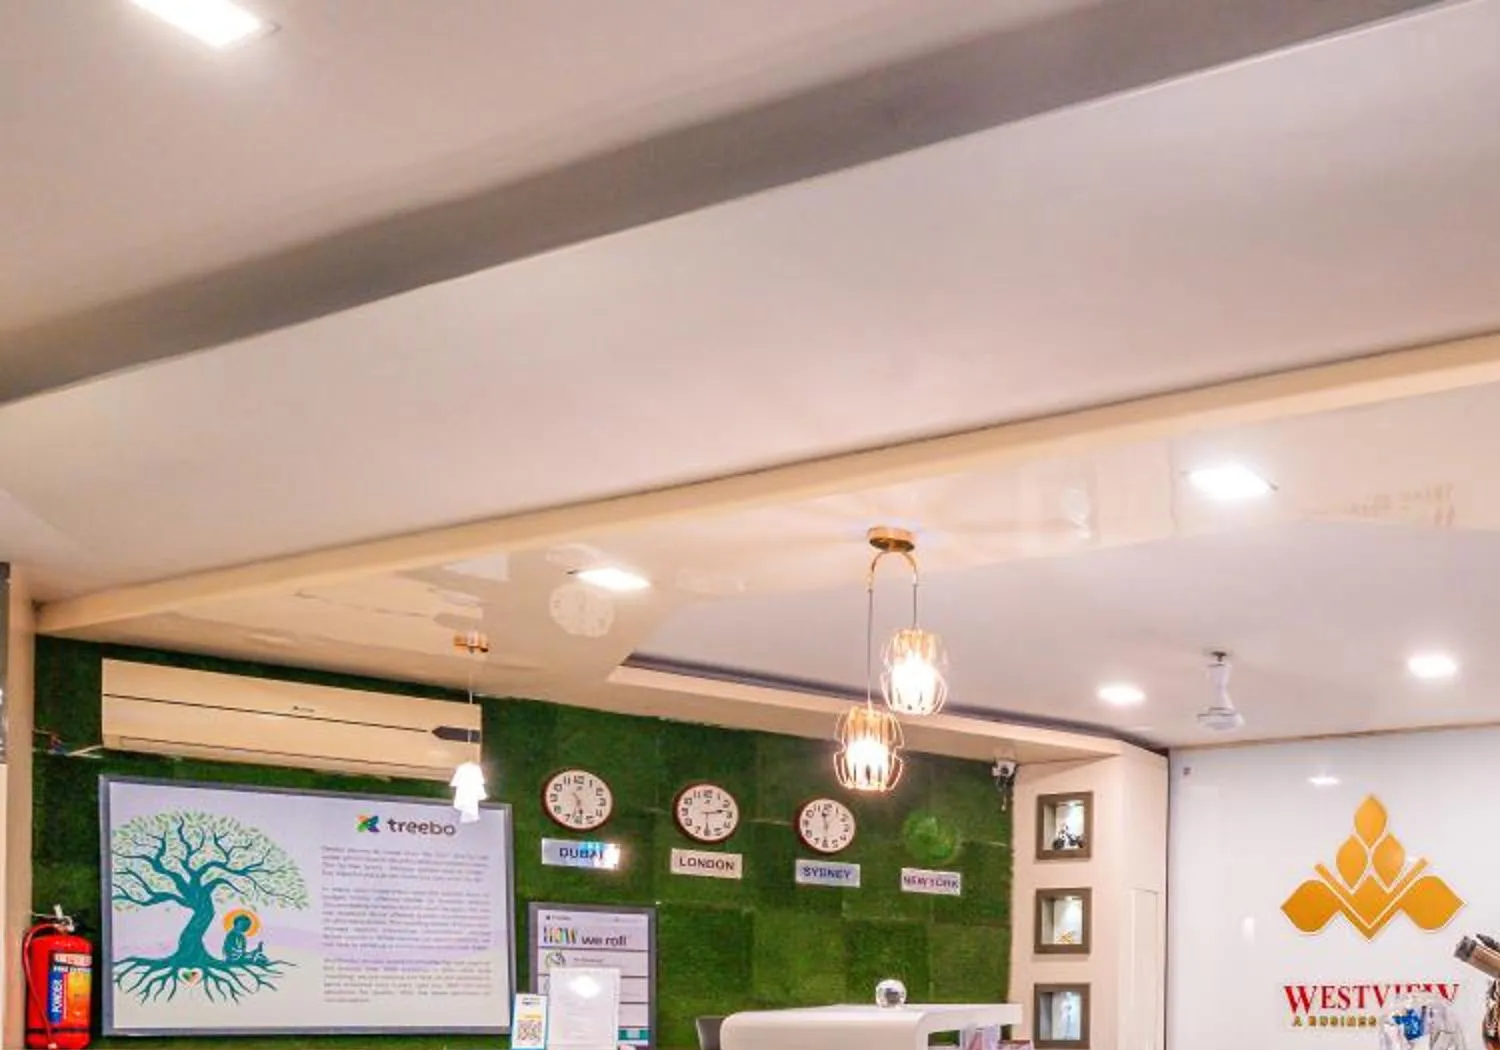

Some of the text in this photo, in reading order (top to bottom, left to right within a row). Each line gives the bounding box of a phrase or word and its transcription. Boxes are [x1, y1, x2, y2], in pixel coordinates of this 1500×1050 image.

[387, 816, 457, 837] treebo
[679, 856, 735, 871] LONDON
[803, 866, 851, 880] SYDNEY
[605, 935, 627, 946] roll
